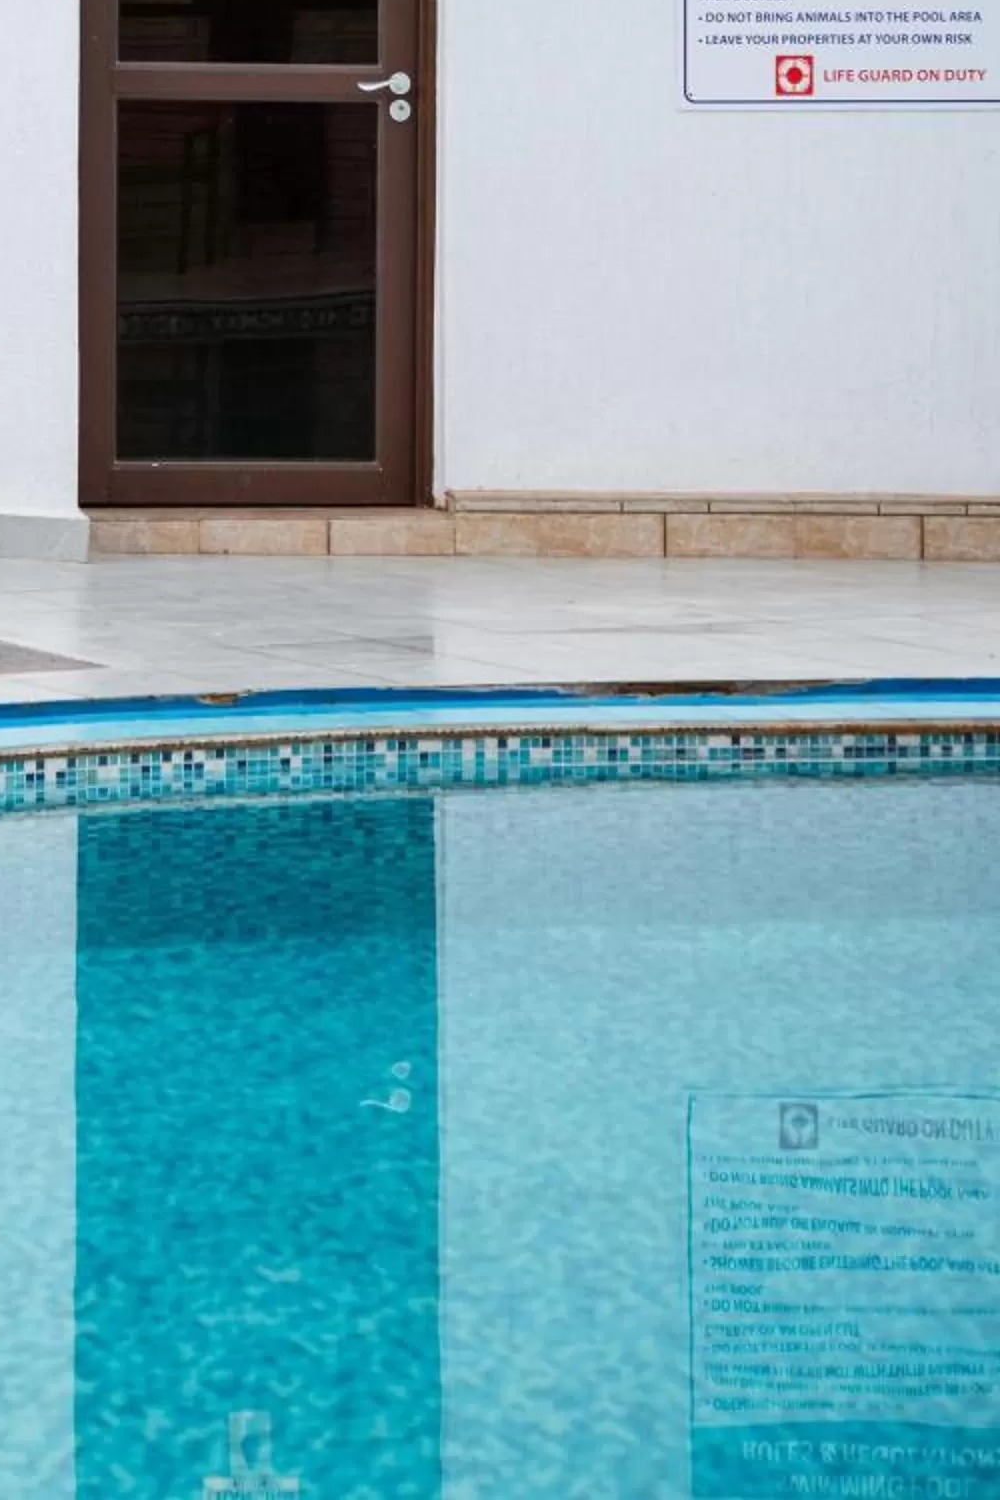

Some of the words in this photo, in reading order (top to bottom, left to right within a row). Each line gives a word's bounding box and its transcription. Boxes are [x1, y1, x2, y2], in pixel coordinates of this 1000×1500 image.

[705, 12, 724, 23] DO
[727, 12, 752, 22] NOT
[755, 12, 793, 22] BRING
[796, 12, 852, 22] ANIMALS
[855, 12, 885, 22] INTO
[887, 12, 909, 22] THE
[912, 12, 946, 22] POOL
[949, 12, 982, 21] AREA
[705, 35, 743, 44] LEAVE
[746, 35, 779, 44] YOUR
[782, 34, 855, 44] PROPERTIES
[858, 34, 872, 44] AT
[875, 34, 909, 44] YOUR
[911, 34, 942, 44] OWN
[945, 34, 973, 44] RISK
[824, 70, 855, 82] LIFE
[858, 70, 913, 82] GUARD
[917, 70, 941, 81] ON
[944, 69, 987, 81] DUTY
